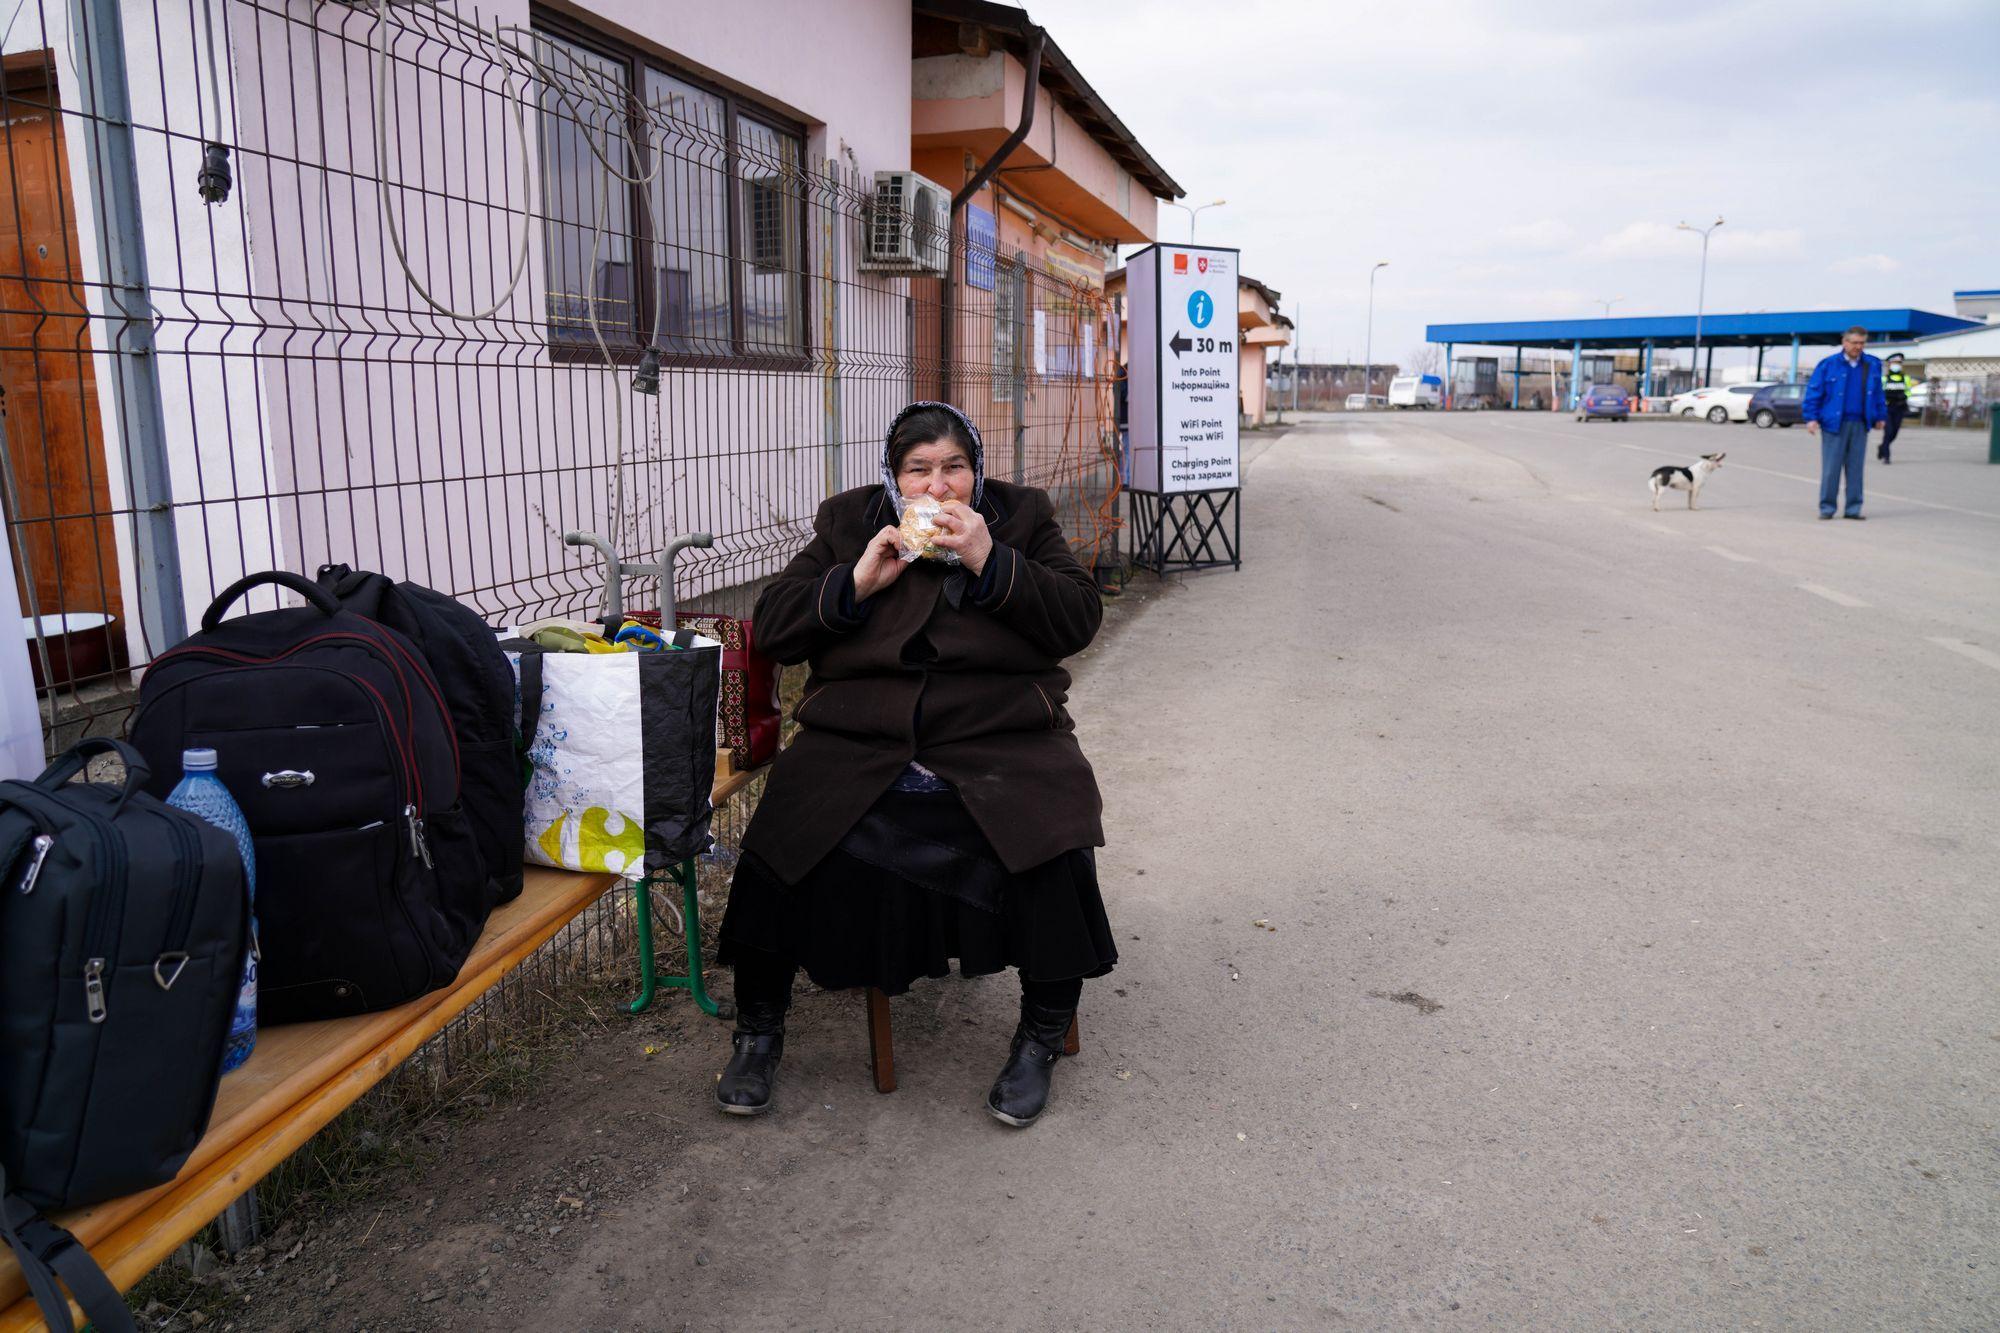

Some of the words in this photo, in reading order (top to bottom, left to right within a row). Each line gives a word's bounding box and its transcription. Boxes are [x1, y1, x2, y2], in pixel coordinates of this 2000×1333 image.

[1196, 338, 1214, 353] 30
[1219, 341, 1232, 353] m
[1181, 368, 1197, 377] Info
[1200, 367, 1221, 377] Point
[1172, 380, 1230, 391] Інформаційна
[1190, 395, 1213, 403] точка
[1181, 420, 1199, 429] WiFi
[1201, 419, 1222, 428] Point
[1180, 434, 1203, 442] точка
[1206, 432, 1224, 441] WiFi
[1171, 459, 1209, 469] Charging
[1211, 456, 1232, 466] Point
[1172, 474, 1195, 482] точка
[1198, 471, 1232, 481] зарядки
